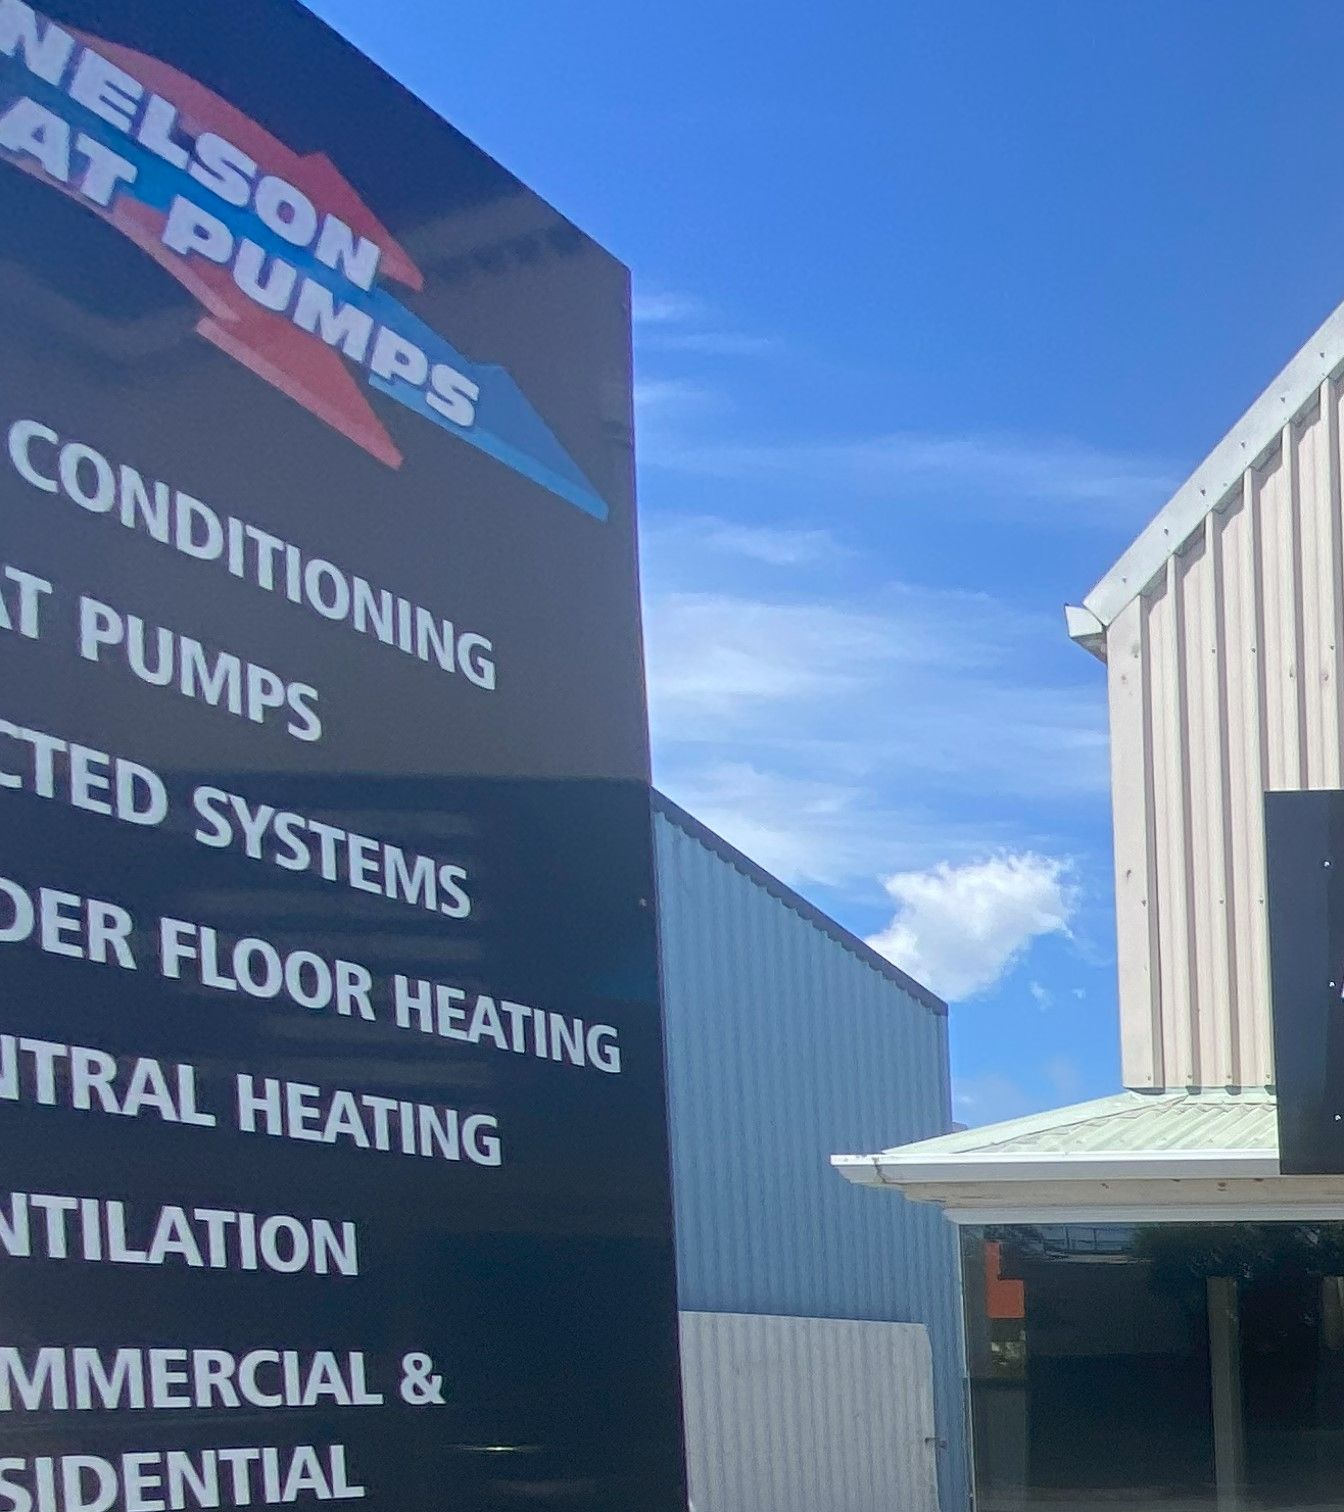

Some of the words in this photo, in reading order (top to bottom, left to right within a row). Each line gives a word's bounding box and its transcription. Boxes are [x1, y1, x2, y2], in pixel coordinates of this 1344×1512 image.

[0, 0, 380, 291] NELSON
[162, 195, 480, 427] PUMPS
[8, 420, 496, 690] CONDITIONING
[80, 596, 322, 741] PUMPS
[194, 787, 470, 917] SYSTEMS
[161, 917, 376, 1020] FLOOR
[395, 975, 620, 1072] HEATING
[237, 1074, 501, 1165] HEATING
[400, 1353, 445, 1404] &
